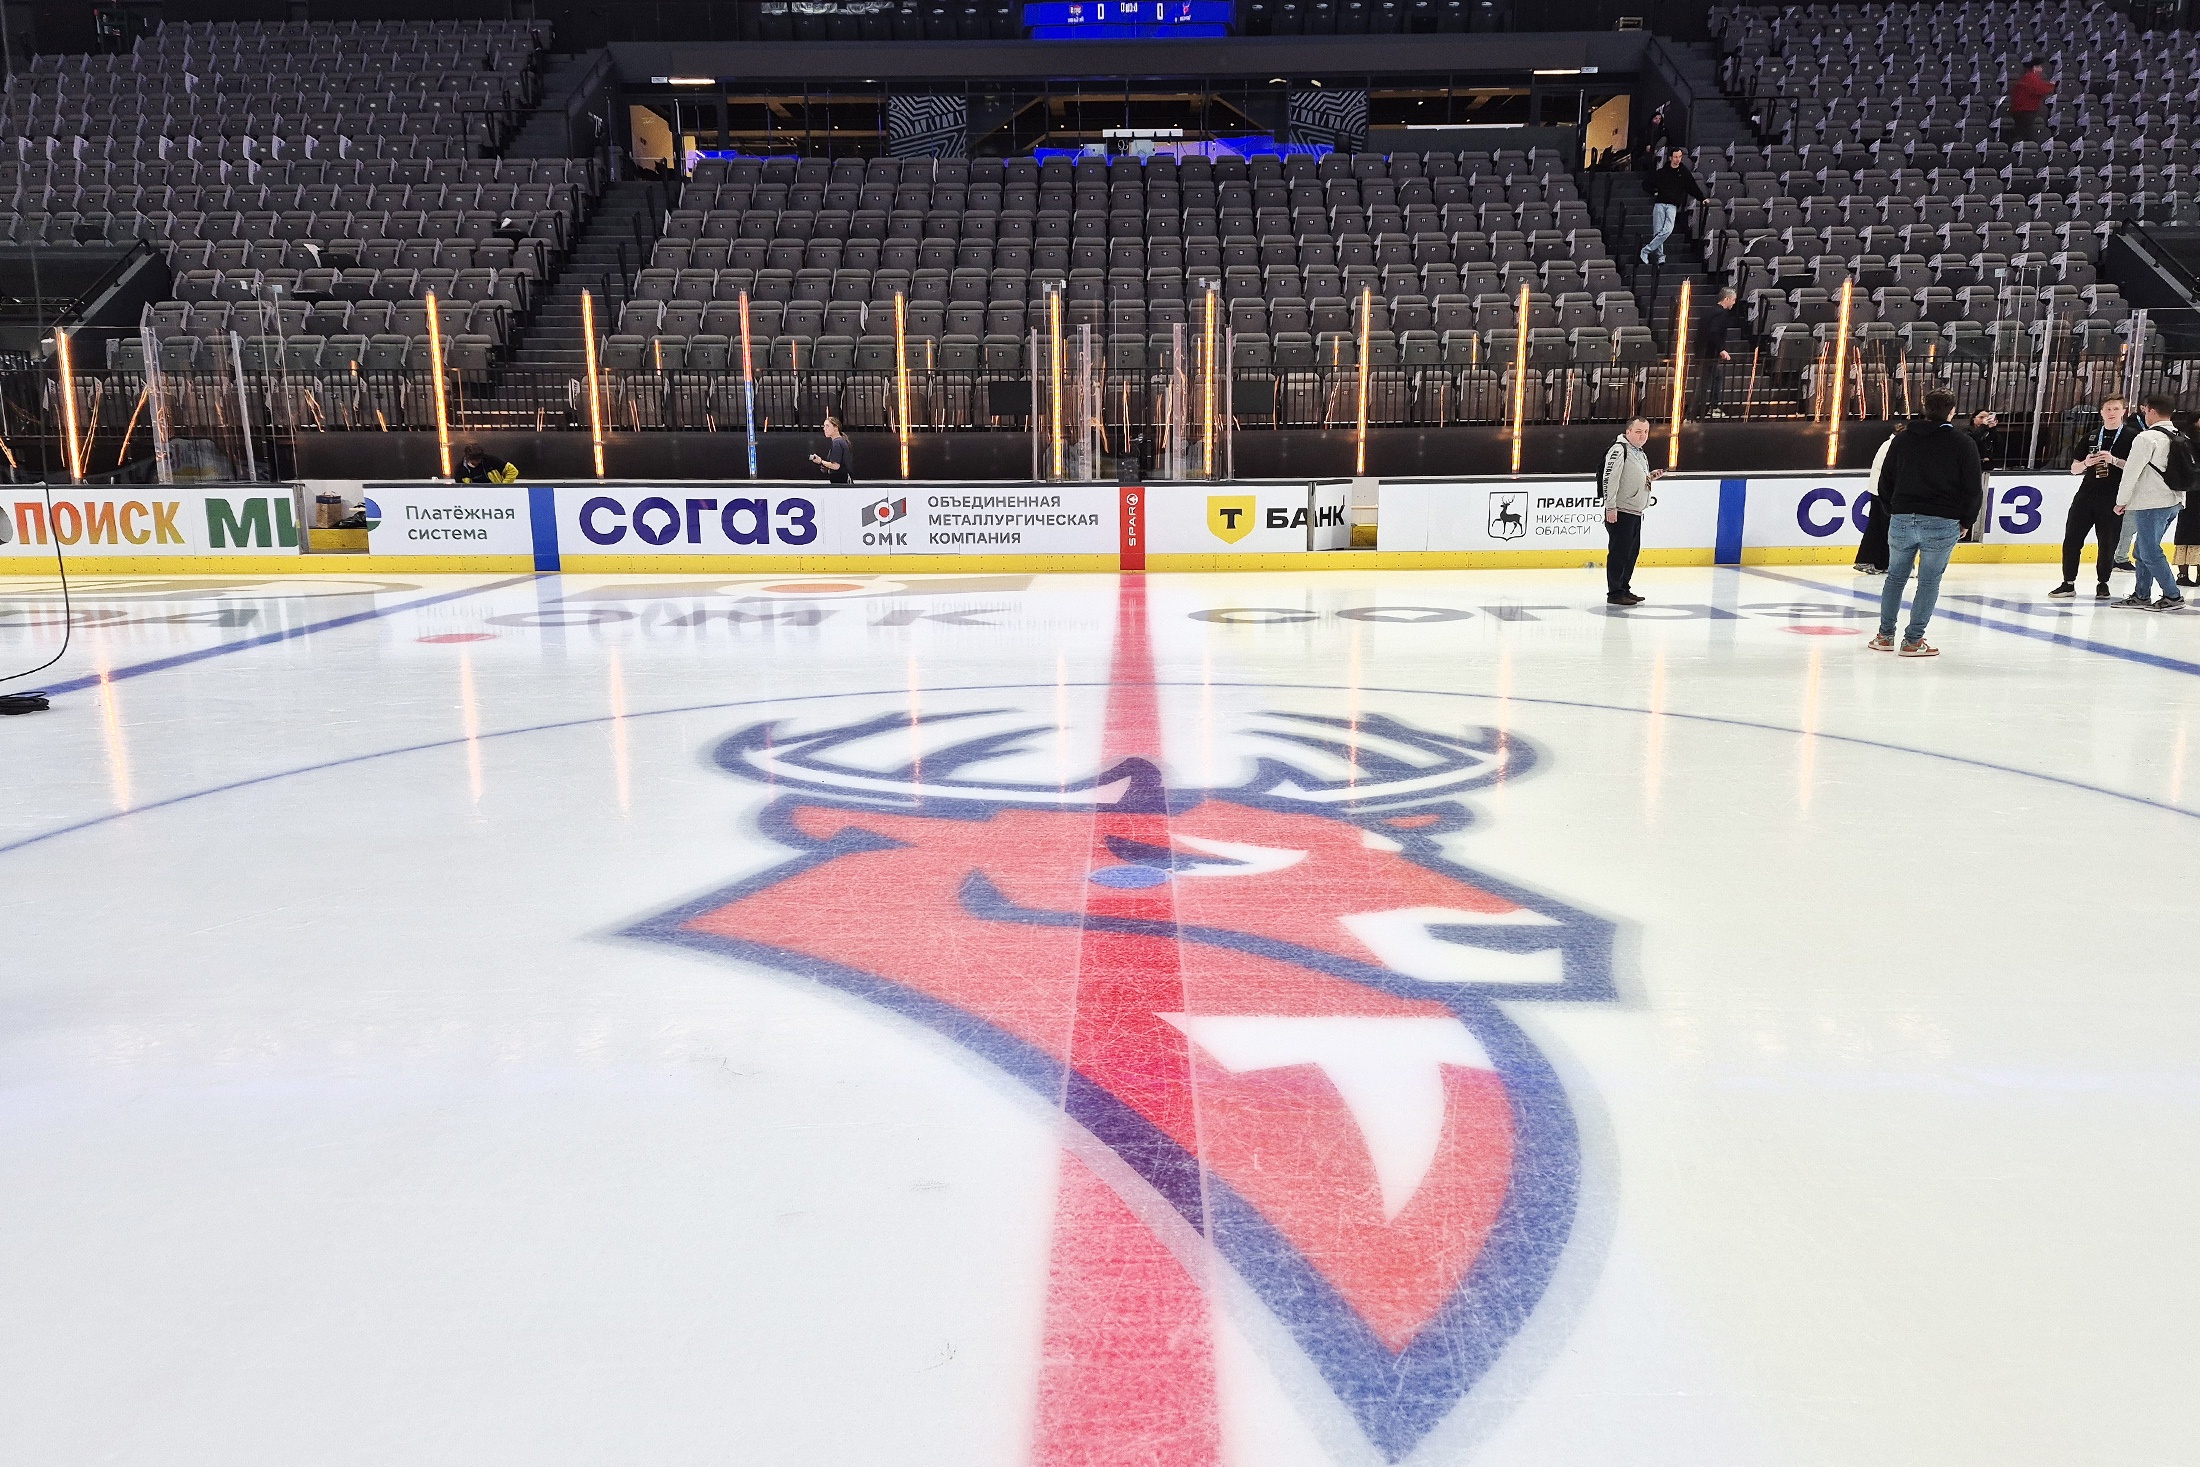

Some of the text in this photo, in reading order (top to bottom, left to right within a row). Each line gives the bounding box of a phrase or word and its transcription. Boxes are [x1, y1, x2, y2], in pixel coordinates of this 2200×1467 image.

[927, 496, 1061, 509] ОБЪЕДИНЕННАЯ
[406, 505, 515, 520] Платёжная
[14, 501, 186, 545] ПОИСК
[928, 514, 1099, 526] МЕТАЛЛУРГИЧЕСКАЯ
[1128, 506, 1136, 546] SPAR
[408, 529, 488, 540] система
[1535, 526, 1591, 535] ОБЛАСТИ
[862, 533, 908, 546] ОМК
[929, 532, 1021, 544] КОМПАНИЯ
